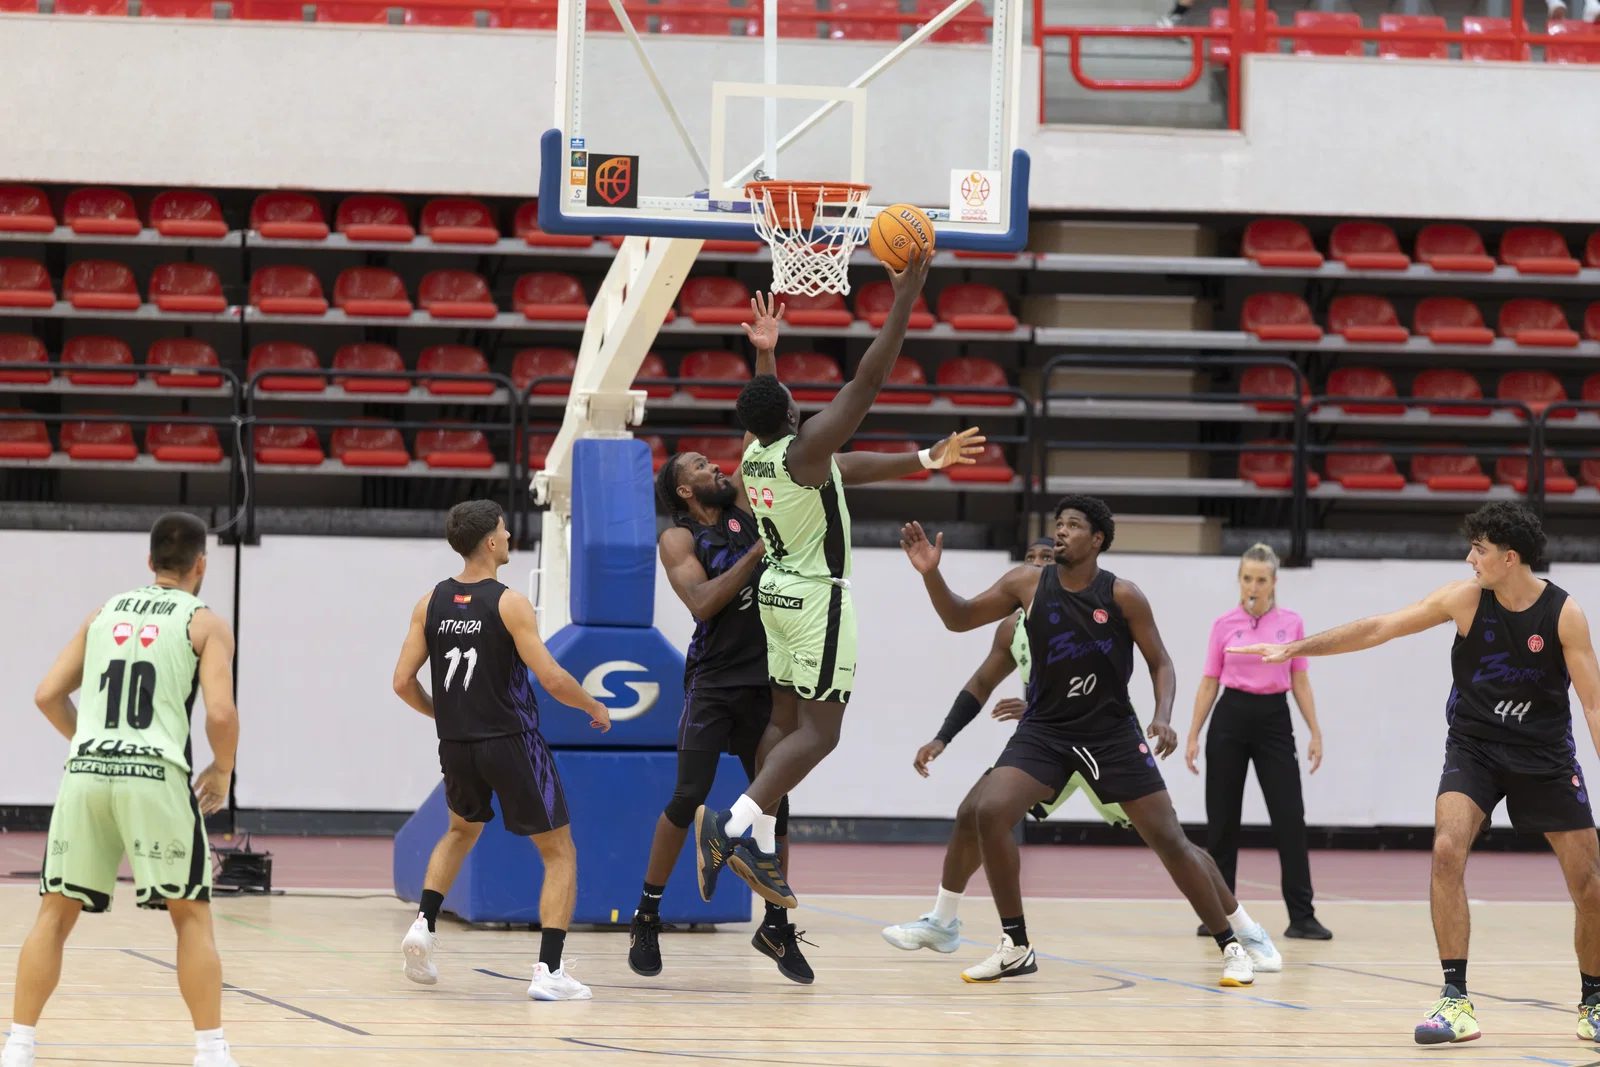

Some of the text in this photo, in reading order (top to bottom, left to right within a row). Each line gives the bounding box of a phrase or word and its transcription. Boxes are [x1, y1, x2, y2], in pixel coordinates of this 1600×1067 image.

[961, 208, 988, 216] COPA
[114, 598, 178, 616] DE LA RÚA
[437, 619, 482, 635] ATIENZA
[443, 646, 478, 693] 11
[99, 659, 157, 730] 10
[1066, 672, 1098, 699] 20
[1493, 699, 1533, 724] 44
[70, 760, 165, 780] BIZAKARTING
